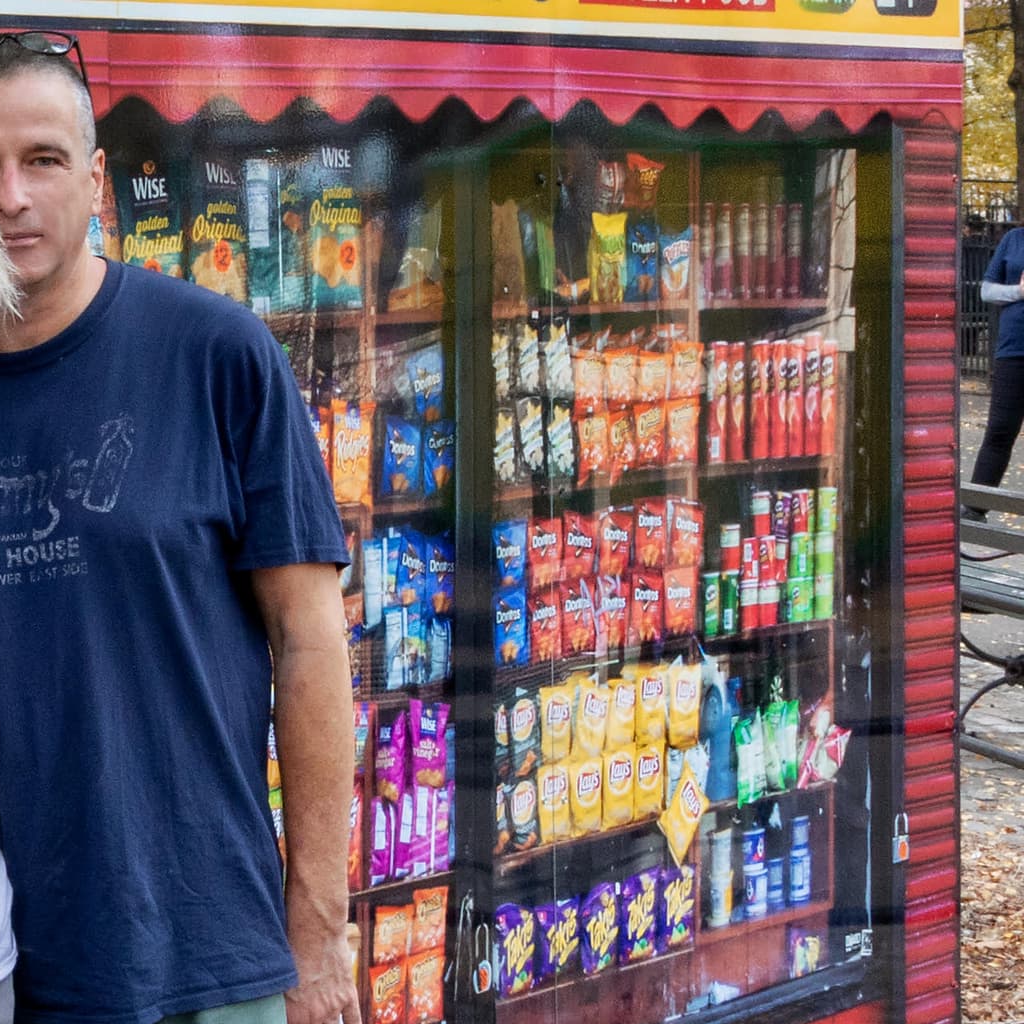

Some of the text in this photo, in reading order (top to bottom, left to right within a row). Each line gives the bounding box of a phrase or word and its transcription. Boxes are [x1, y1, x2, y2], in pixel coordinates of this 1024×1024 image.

[322, 147, 351, 168] WISE
[132, 177, 167, 201] WISE
[136, 216, 170, 237] golden
[123, 231, 184, 263] Original
[6, 536, 81, 568] HOUSE
